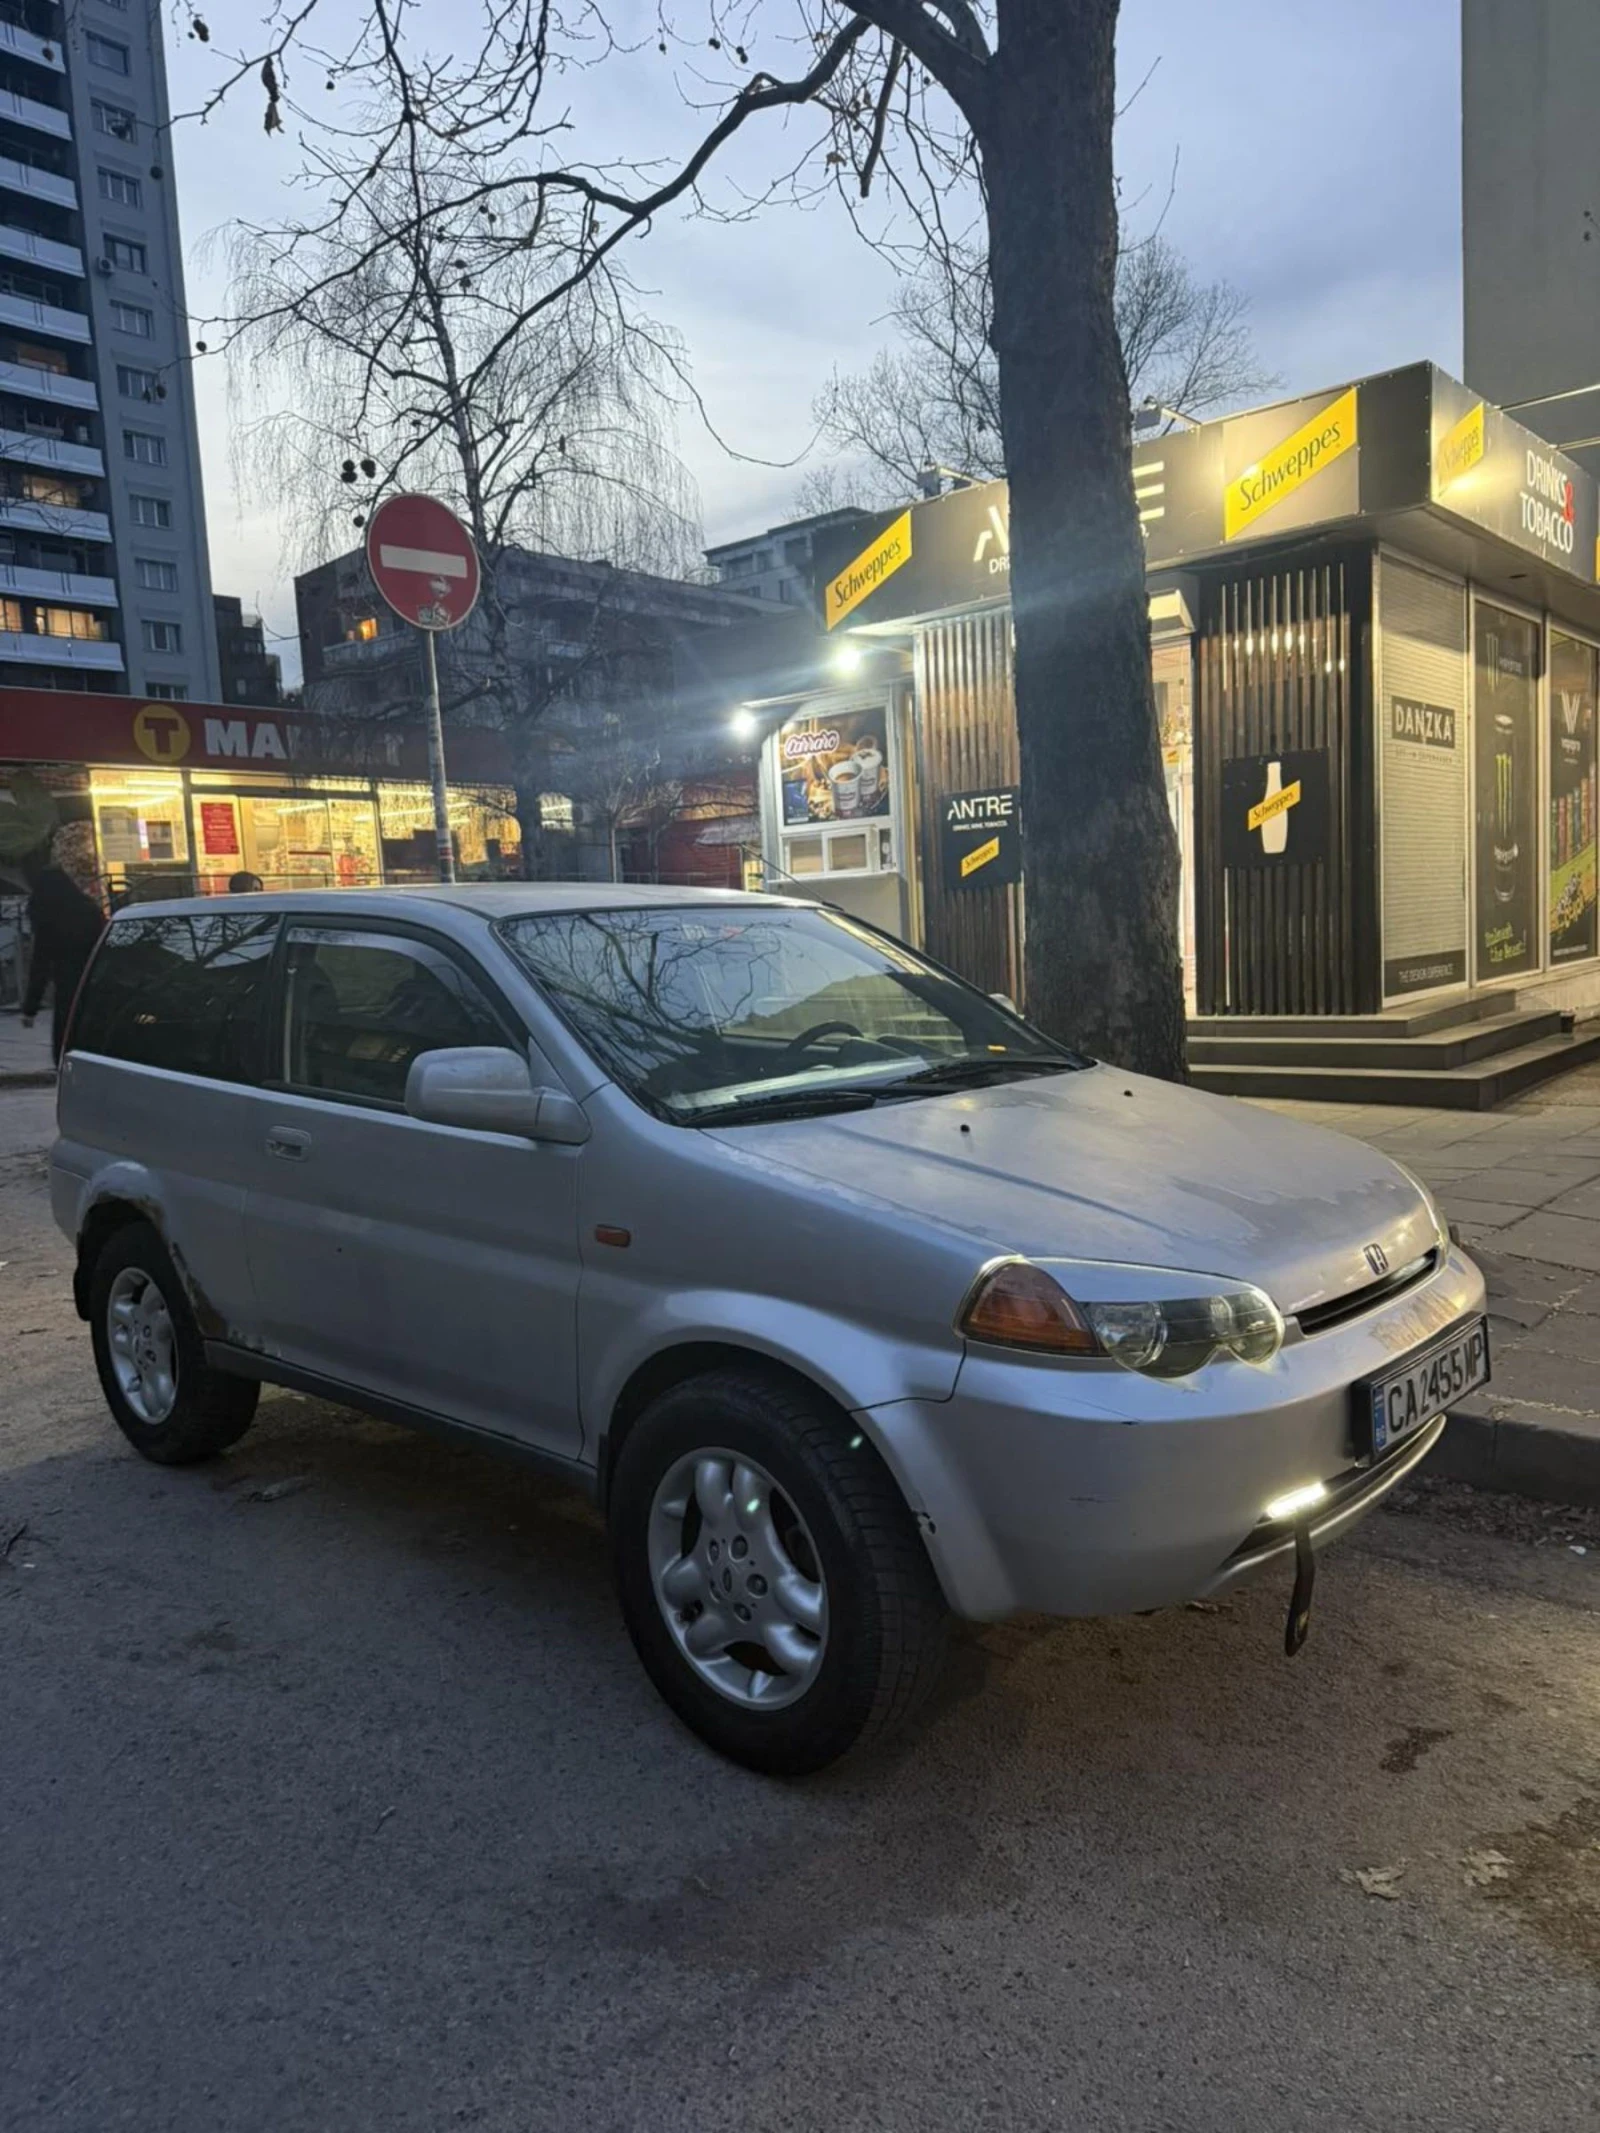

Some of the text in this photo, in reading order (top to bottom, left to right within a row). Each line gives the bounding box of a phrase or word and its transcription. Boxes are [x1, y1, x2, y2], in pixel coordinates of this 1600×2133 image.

[1240, 421, 1341, 511] Schweppes
[1526, 449, 1568, 508] DRINKS
[1519, 490, 1574, 554] TOBACCO
[834, 536, 901, 608] Schweppes
[143, 716, 180, 755] T
[1395, 705, 1453, 742] DANZKA
[947, 793, 1013, 821] ANTRE
